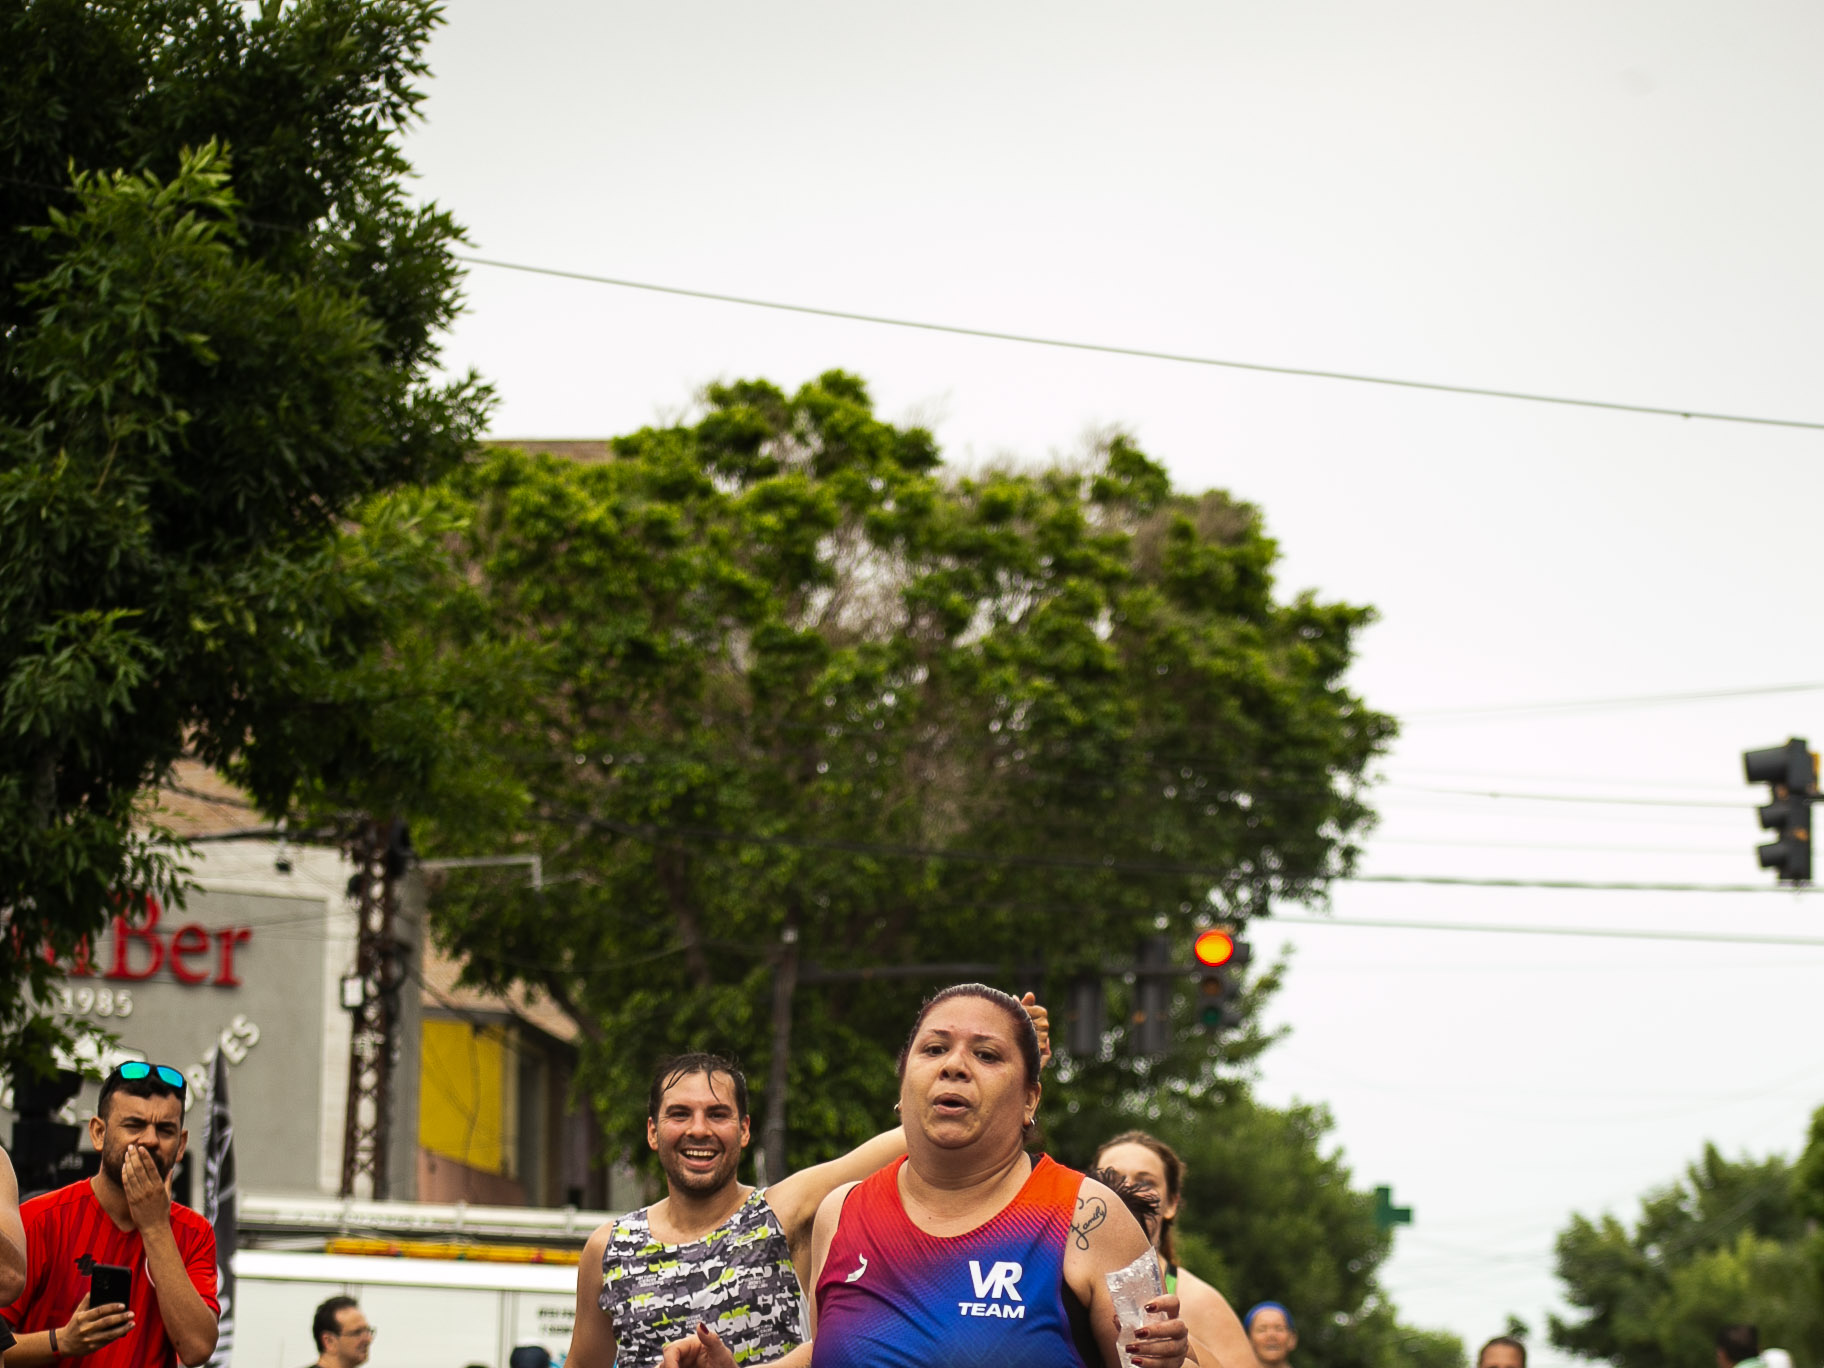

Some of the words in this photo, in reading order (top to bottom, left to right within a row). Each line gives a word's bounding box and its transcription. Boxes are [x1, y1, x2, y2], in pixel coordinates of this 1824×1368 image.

[60, 987, 134, 1017] 1985
[968, 1260, 1023, 1302] VR
[958, 1302, 1025, 1319] TEAM
